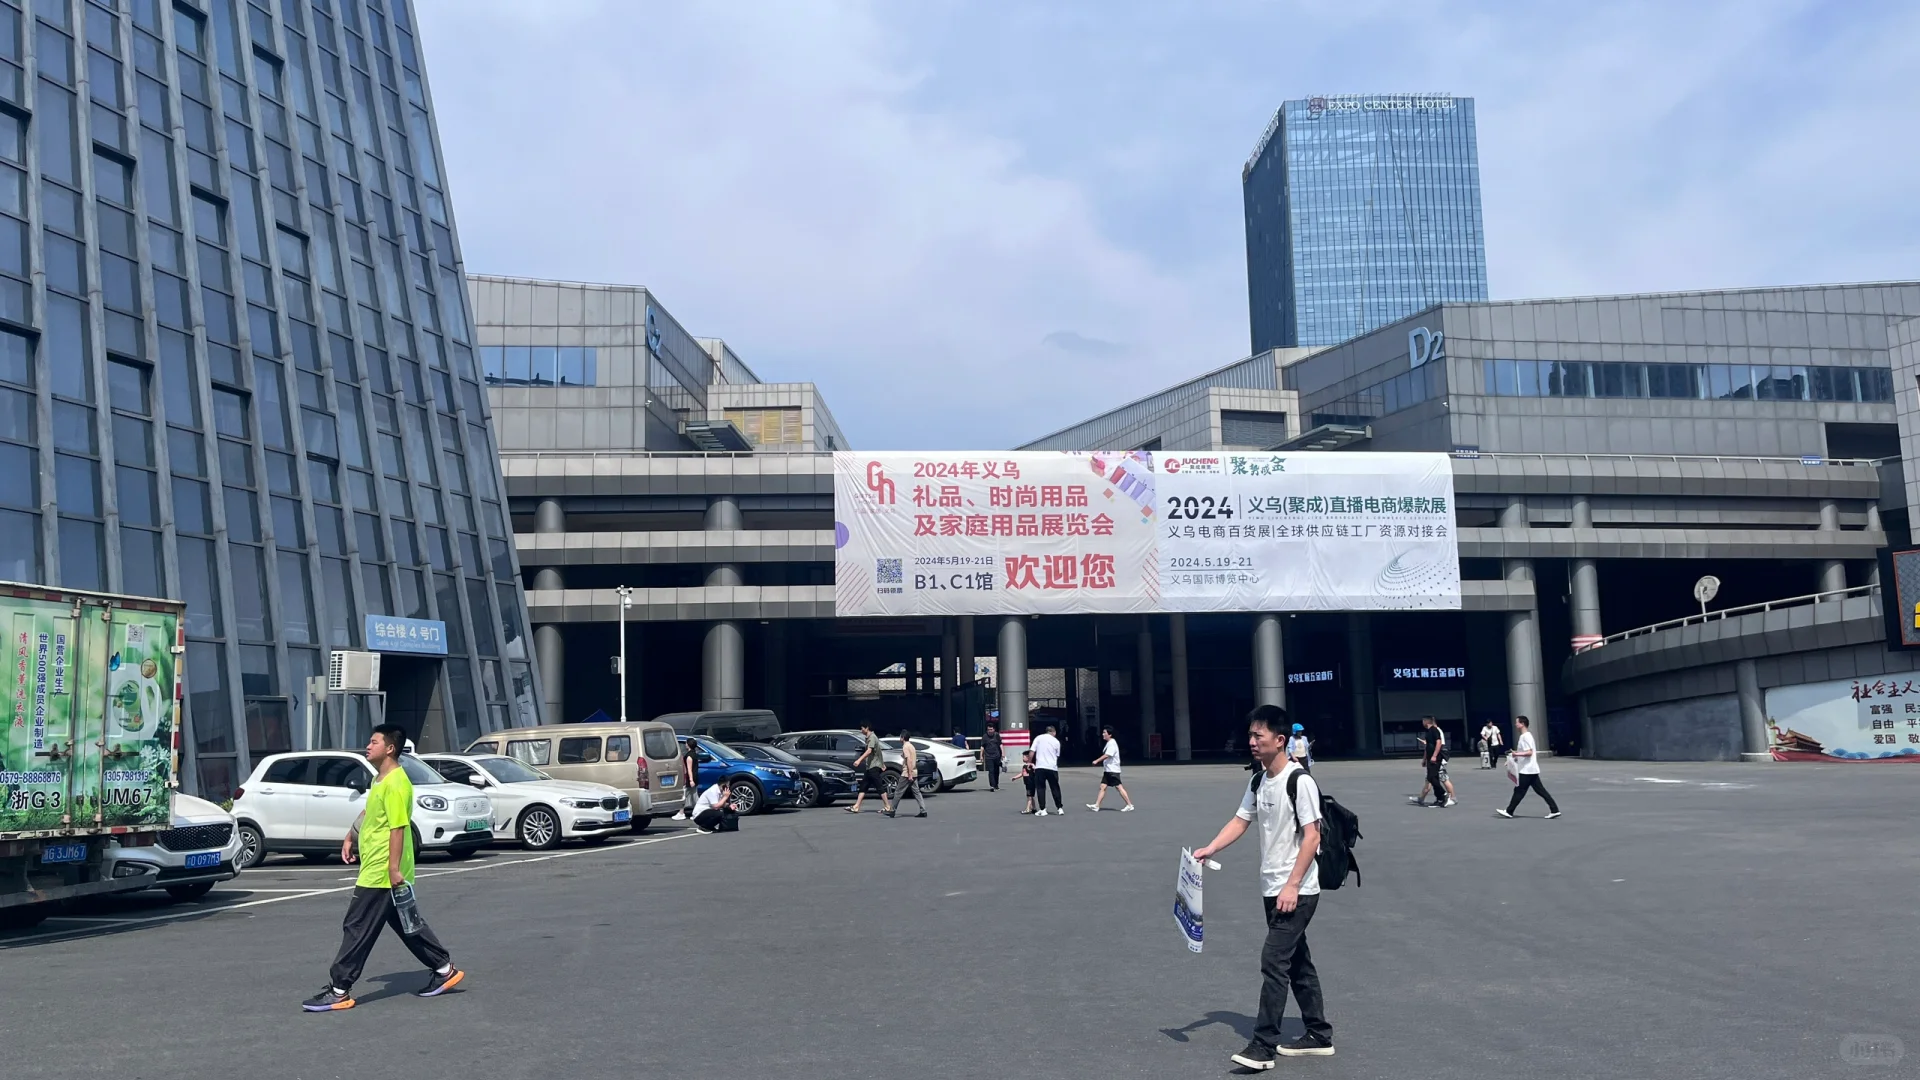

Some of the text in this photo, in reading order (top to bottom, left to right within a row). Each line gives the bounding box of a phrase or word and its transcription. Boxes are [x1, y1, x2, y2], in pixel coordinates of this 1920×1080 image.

[1328, 99, 1457, 110] EXPO CENTER HOTEL
[1408, 327, 1444, 368] D2
[914, 461, 1020, 479] 2024年义乌
[912, 485, 1088, 507] 礼品、时尚用品
[1167, 496, 1234, 519] 2024
[1248, 496, 1447, 515] 义乌(聚成)直播电商爆款展
[914, 513, 1114, 536] 及家庭用品展览会
[915, 556, 993, 565] 2024年5月19-21日
[1171, 557, 1252, 567] 2024.5.19-21
[915, 572, 993, 590] B1、C1馆
[1005, 554, 1115, 590] 欢迎您
[1171, 574, 1259, 585] 义乌国际博览中心
[54, 634, 66, 698] 国营企业生产
[1851, 680, 1920, 703] 社会主义
[1869, 704, 1893, 715] 富强
[1872, 718, 1920, 729] 自由 平
[1874, 734, 1896, 744] 爱国
[0, 770, 61, 783] 0579-88868876
[102, 788, 152, 805] JM67
